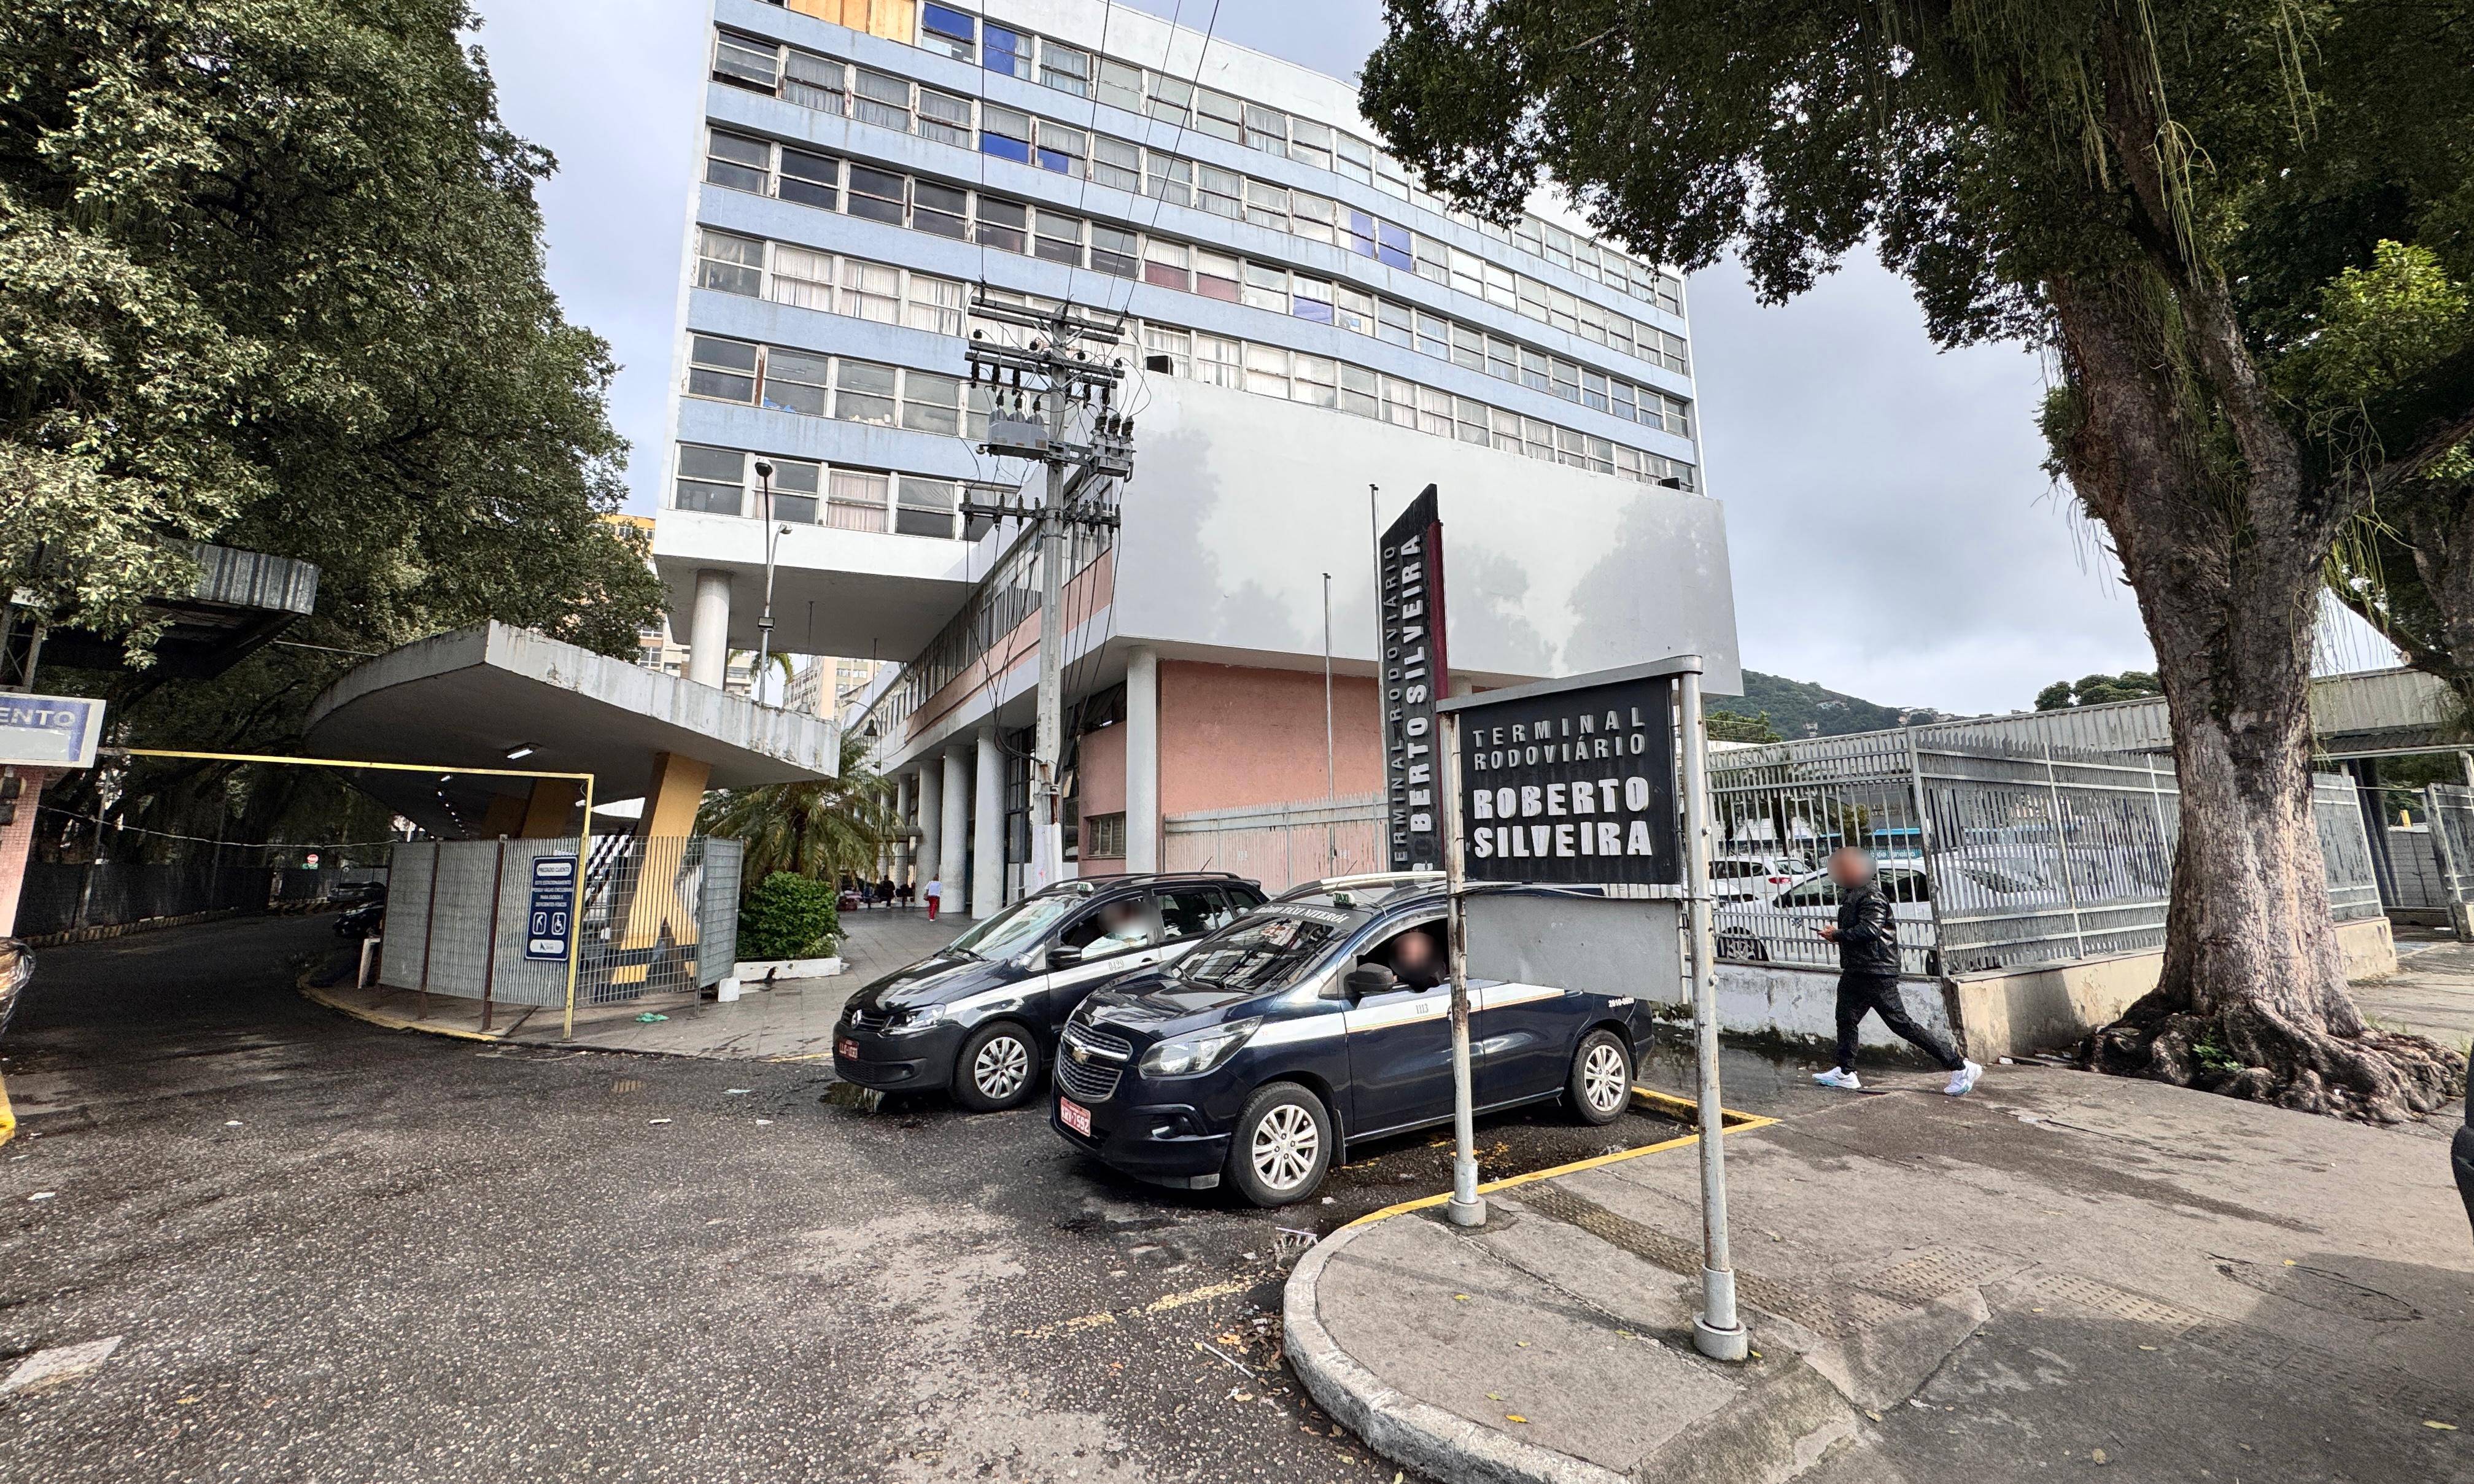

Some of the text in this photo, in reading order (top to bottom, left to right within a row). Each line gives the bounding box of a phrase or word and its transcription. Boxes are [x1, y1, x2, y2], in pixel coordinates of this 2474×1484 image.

[1400, 534, 1427, 705] SILVEIRA
[1382, 546, 1408, 862] ERMINAL RODOVIÁRIO
[1473, 707, 1646, 748] TERMINAL
[1474, 733, 1646, 771] RODOVIÁRIO
[1473, 776, 1650, 820] ROBERTO
[1473, 820, 1653, 858] SILVEIRA
[1303, 908, 1350, 924] NITERÓI
[1335, 892, 1349, 903] TAXI
[1416, 1003, 1429, 1014] 1113
[1061, 1105, 1090, 1134] KRV-7592
